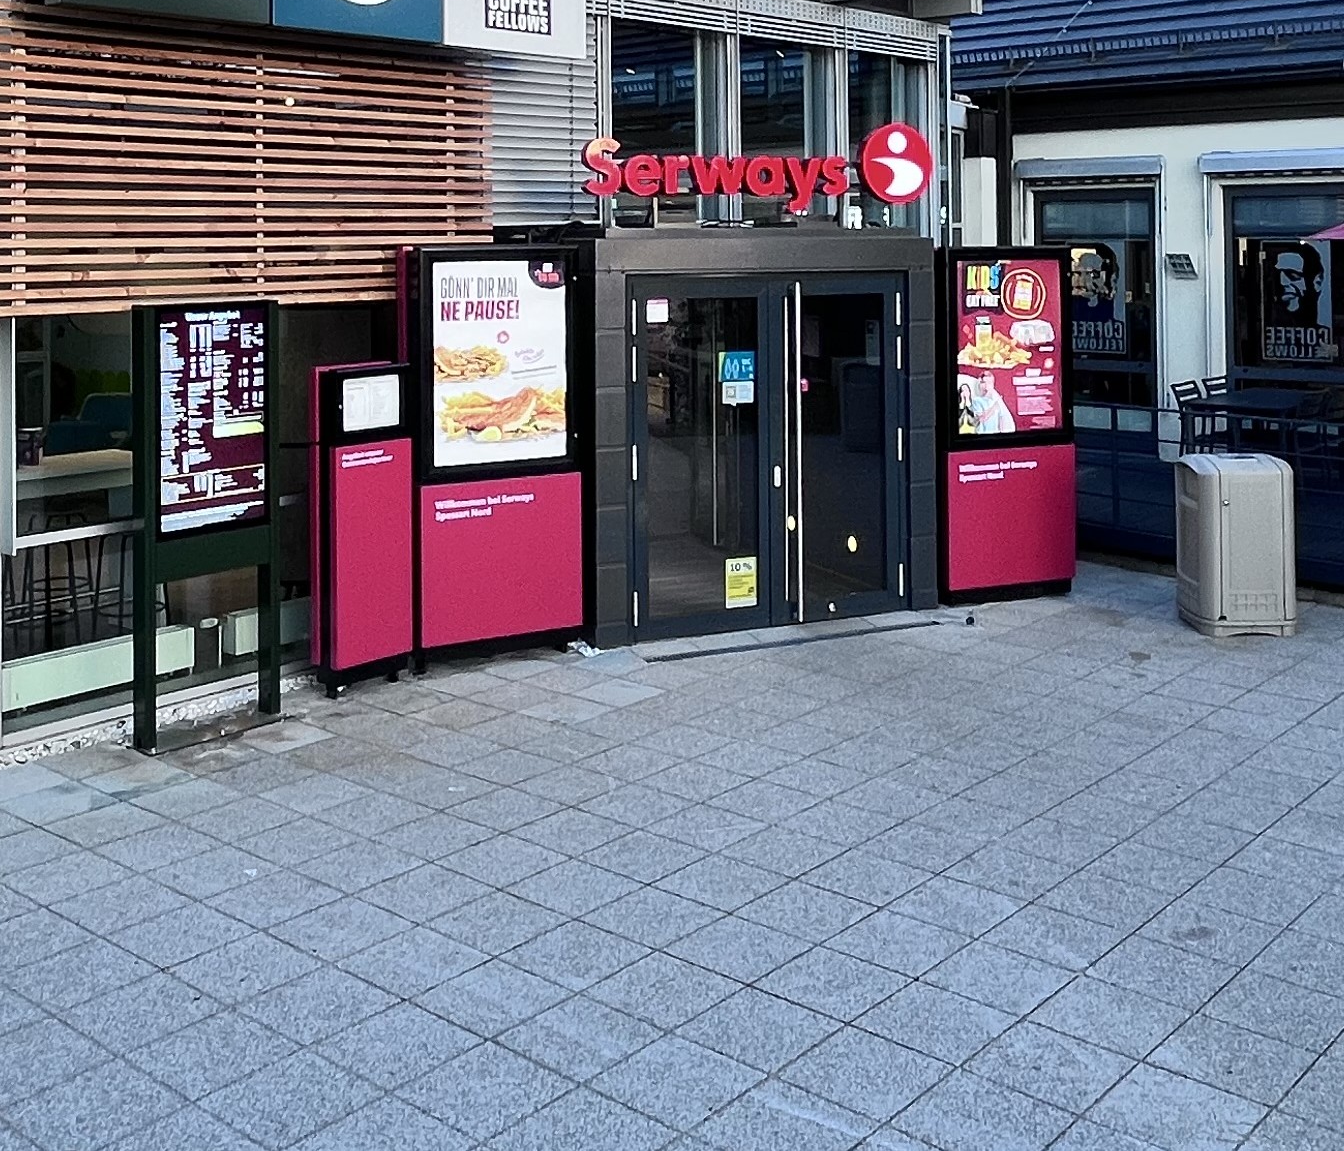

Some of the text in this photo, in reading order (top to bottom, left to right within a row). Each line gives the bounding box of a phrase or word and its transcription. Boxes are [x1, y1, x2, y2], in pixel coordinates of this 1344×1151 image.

[488, 9, 549, 34] FELLOWS
[581, 137, 850, 215] Serways
[476, 276, 495, 298] DIR
[496, 276, 519, 298] MAL
[440, 299, 520, 322] NE PAUSE!
